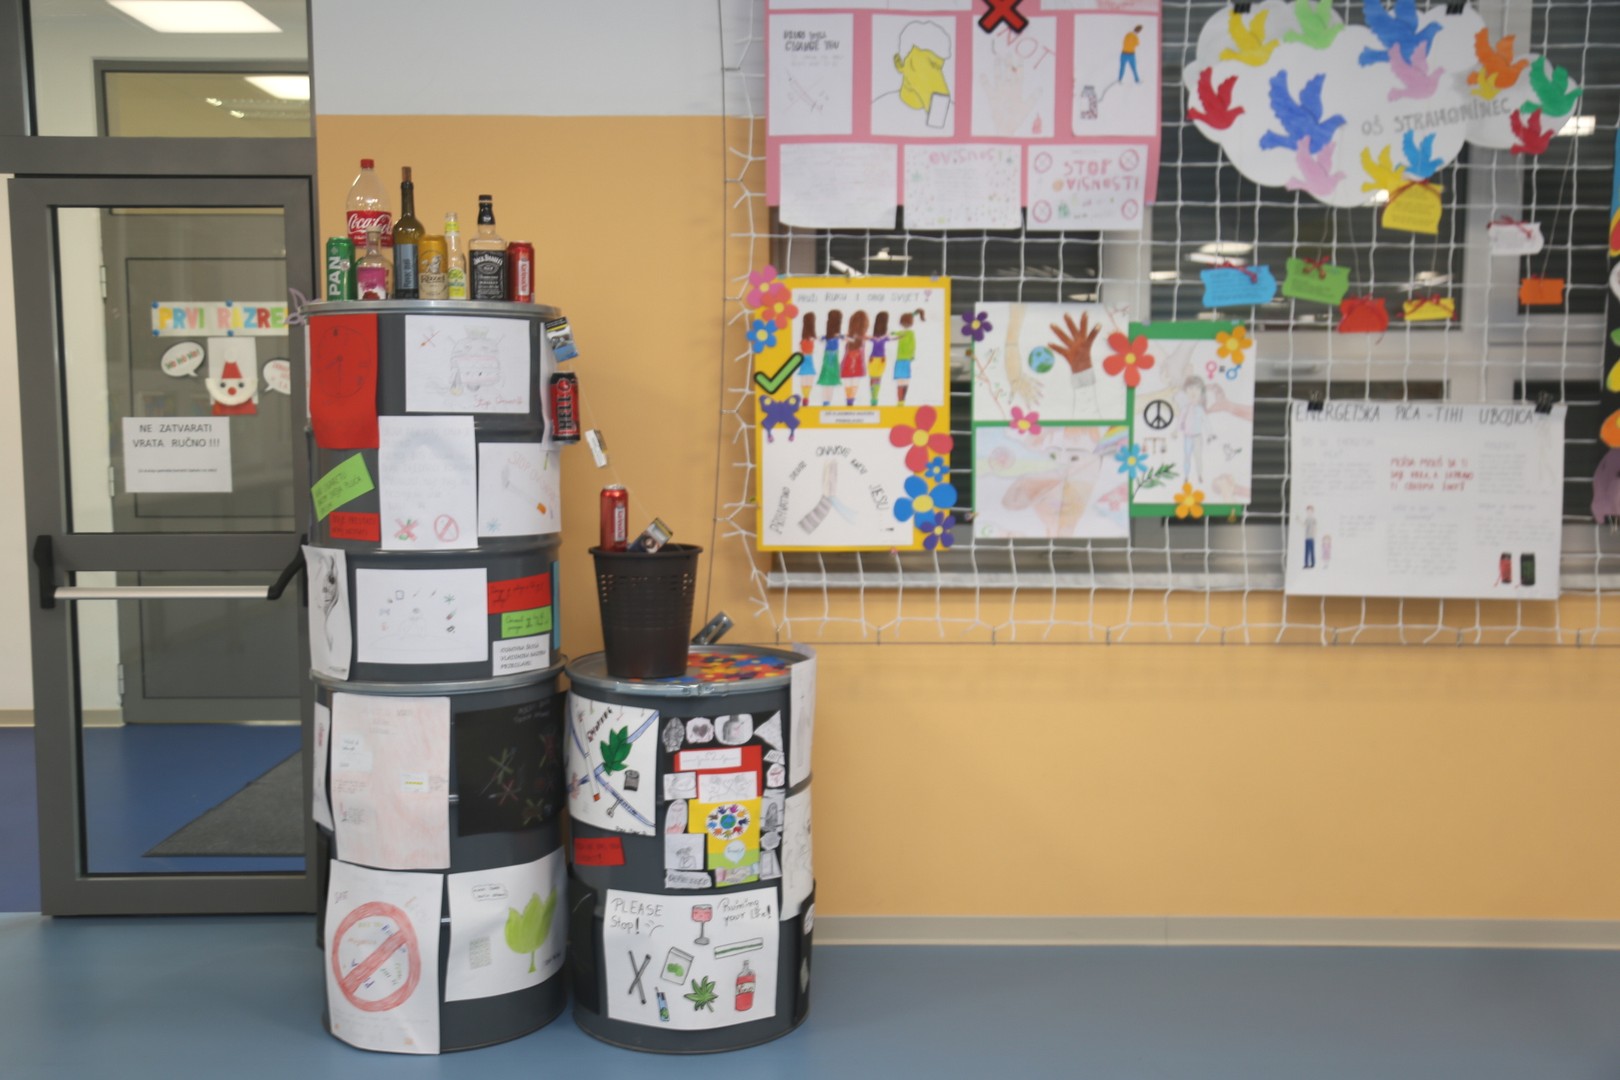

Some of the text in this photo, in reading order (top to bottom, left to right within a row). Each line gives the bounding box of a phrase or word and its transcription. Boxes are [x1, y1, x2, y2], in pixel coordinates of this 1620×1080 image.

[1064, 159, 1112, 176] STOP
[329, 256, 341, 296] PAN
[158, 307, 288, 329] PRVI RAZRE
[556, 395, 573, 431] HELL
[139, 424, 212, 432] NE ZATVARATI
[133, 439, 164, 447] VRATA
[171, 437, 206, 447] RUČNO
[611, 897, 664, 917] PLEASE
